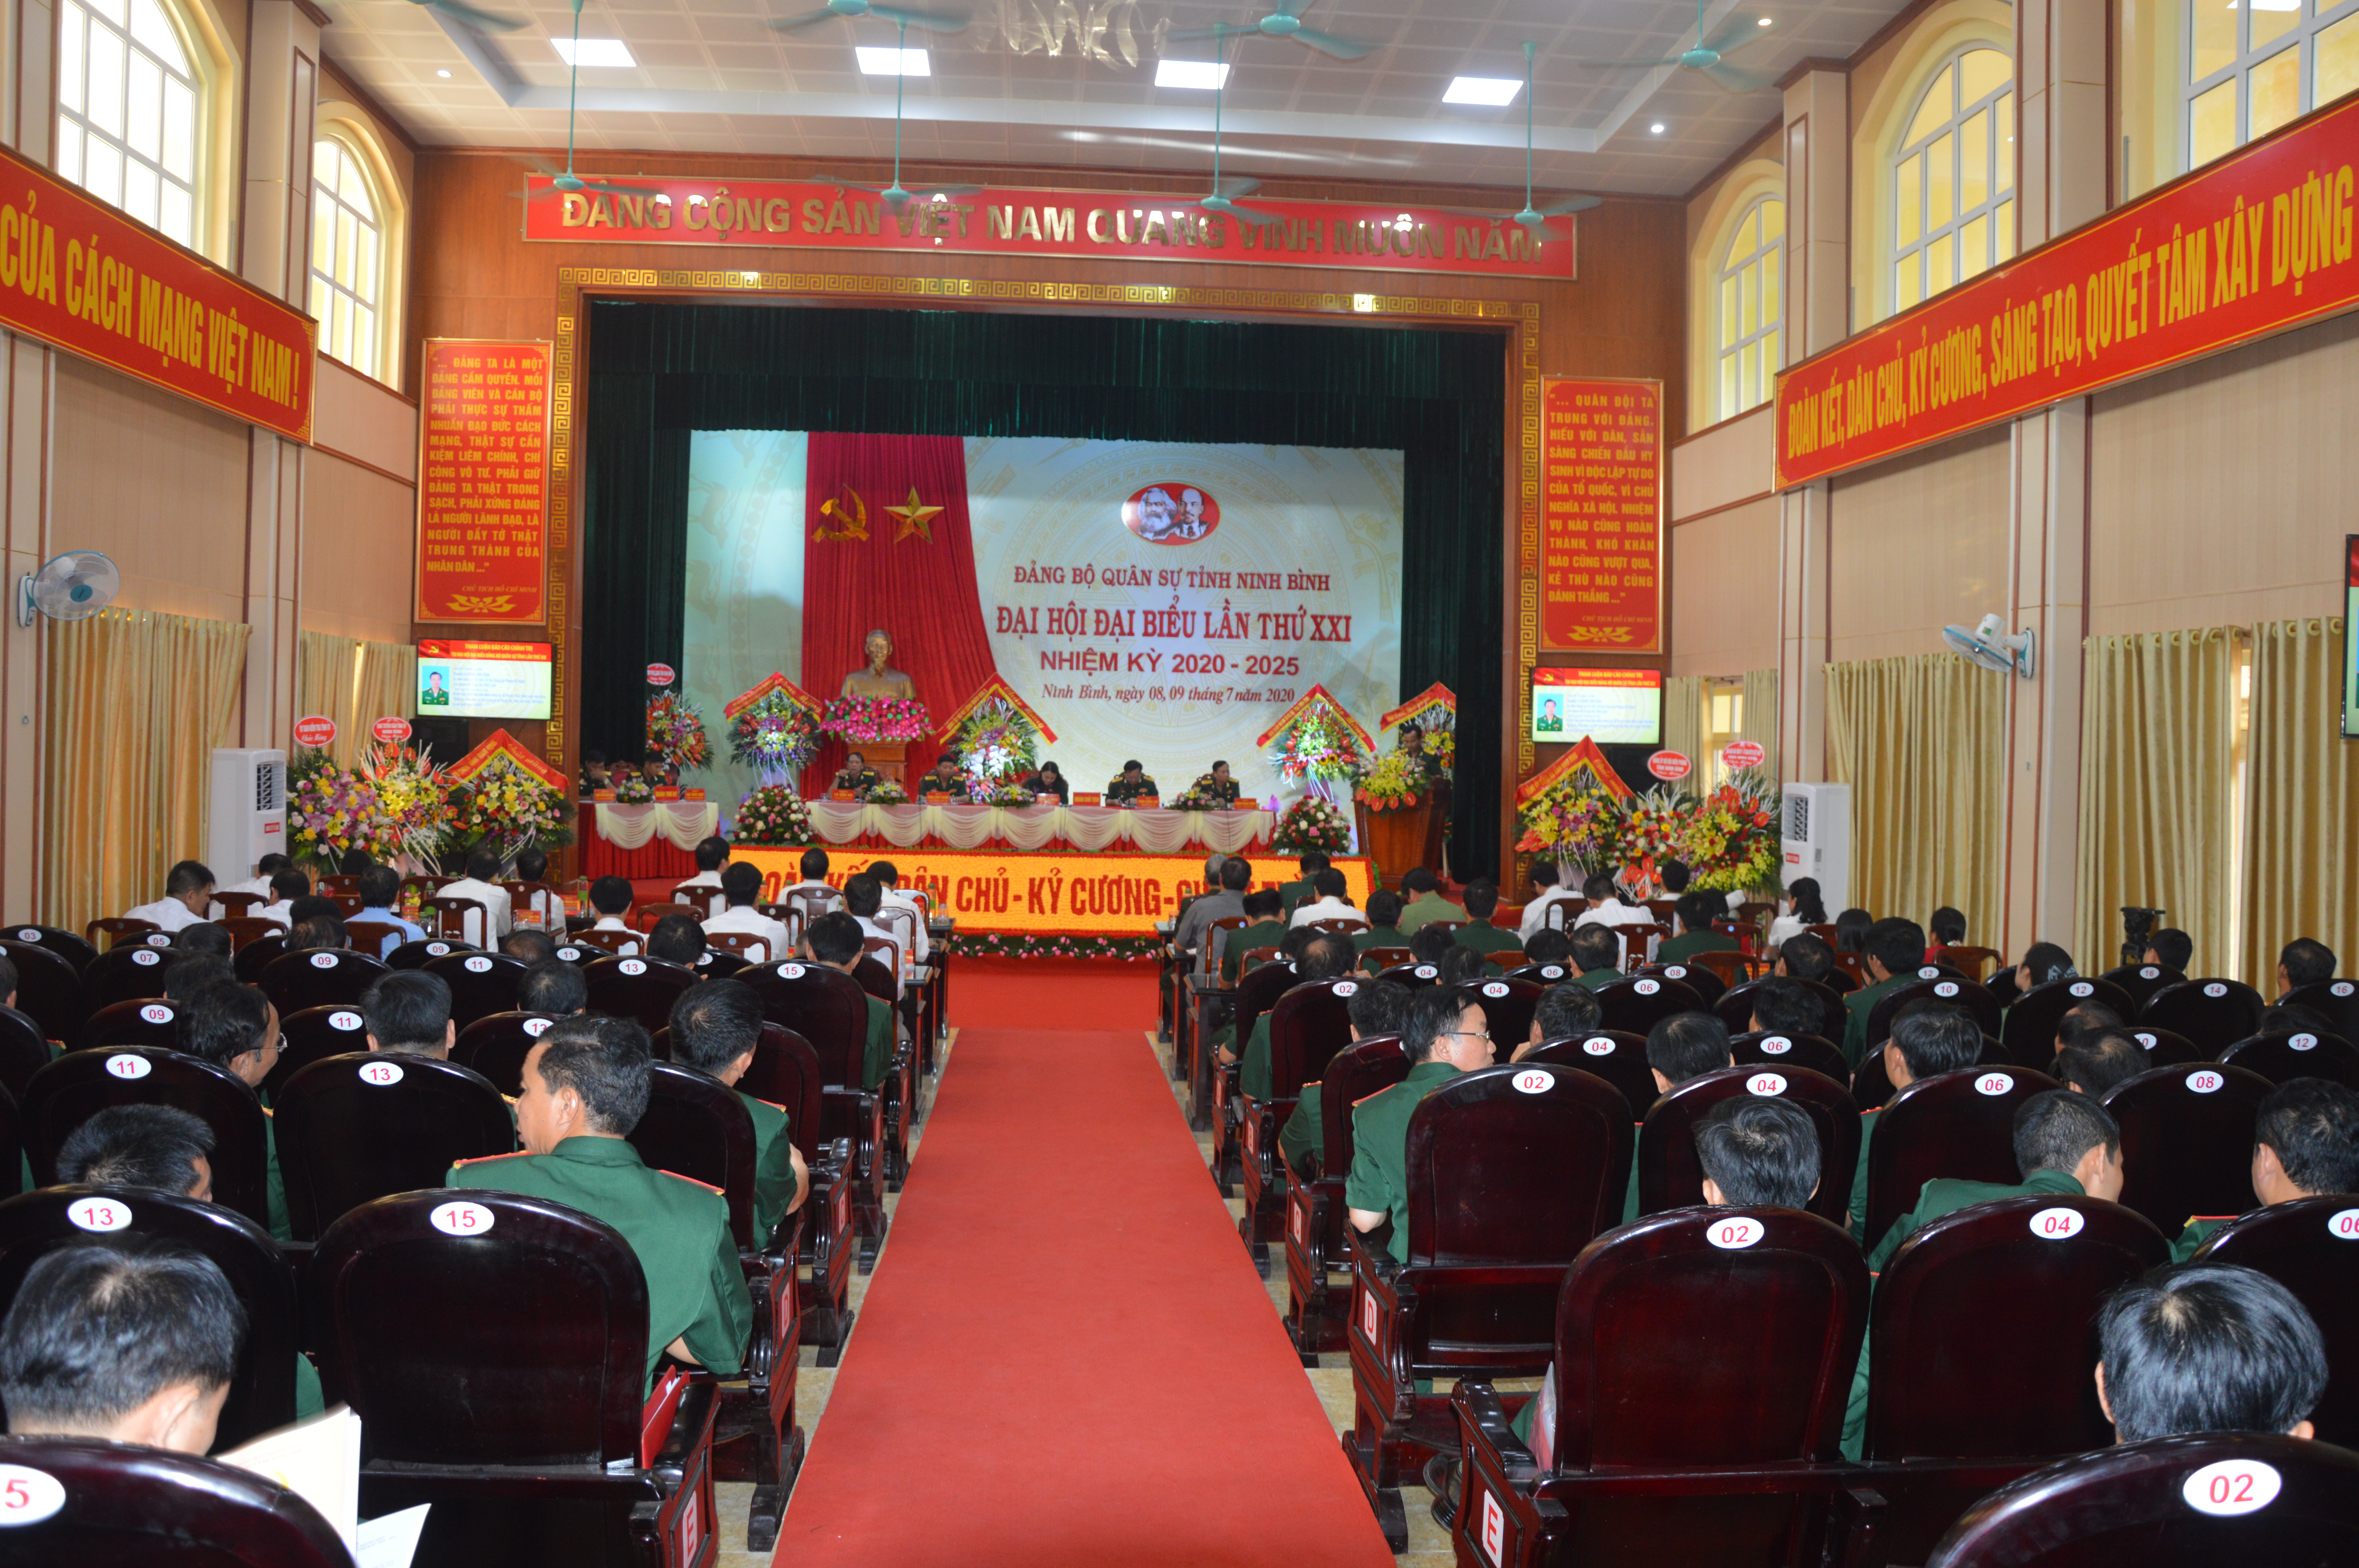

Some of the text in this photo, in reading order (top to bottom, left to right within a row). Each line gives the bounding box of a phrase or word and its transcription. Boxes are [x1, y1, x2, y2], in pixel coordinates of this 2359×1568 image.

[562, 181, 1541, 263] ĐẢNG CỘNG SẢN VIỆT NAM QUANG VINH MUÔN NĂM
[0, 190, 56, 305] CỦA
[65, 234, 133, 338] CÁCH
[139, 273, 204, 368] MẠNG
[209, 307, 248, 394] VIỆT
[1788, 165, 2353, 459] ĐOÀN KẾT, DÂN CHỦ, KỶ CƯƠNG, SÁNG TẠO, QUYẾT TÂM XÂY DỰNG
[432, 386, 542, 403] ĐẢNG VIÊN VÀ CÁN BỘ
[431, 401, 542, 417] PHẢI THỰC SỰ THẤM
[1014, 561, 1330, 591] ĐẢNG BỘ QUÂN SỰ TỈNH NINH BÌNH
[996, 595, 1352, 643] ĐẠI HỘI ĐẠI BIỂU LẦN THỨ XXI
[1041, 647, 1118, 676] NHIỆM
[1128, 648, 1163, 672] KỲ
[1172, 653, 1225, 674] 2020
[1245, 655, 1299, 676] 2025
[1079, 684, 1112, 701] Bình,
[1115, 686, 1145, 703] ngày
[1149, 686, 1166, 702] 08,
[1170, 686, 1185, 700] 09
[1189, 686, 1224, 705] tháng
[1227, 688, 1234, 701] 7
[1235, 689, 1262, 702] năm
[1266, 688, 1295, 702] 2020
[956, 867, 1009, 913] CHỦ
[1028, 867, 1063, 915] KỶ
[24, 932, 36, 940] 03
[432, 945, 444, 954] 09
[140, 953, 153, 962] 07
[318, 957, 332, 965] 09
[472, 961, 483, 969] 11
[625, 964, 638, 973] 13
[784, 966, 798, 976] 15
[1339, 985, 1352, 994] 02
[1489, 986, 1503, 995] 04
[1640, 984, 1654, 992] 06
[149, 1009, 165, 1020] 09
[336, 1016, 351, 1027] 11
[1591, 1042, 1608, 1053] 04
[1767, 1041, 1783, 1051] 06
[2295, 1037, 2309, 1047] 12
[116, 1061, 135, 1074] 11
[370, 1068, 391, 1081] 13
[1523, 1077, 1545, 1090] 02
[1757, 1079, 1777, 1092] 04
[1984, 1078, 2004, 1091] 06
[2196, 1076, 2214, 1088] 08
[83, 1207, 114, 1226] 13
[445, 1210, 477, 1228] 15
[1296, 1210, 1300, 1236] C
[2043, 1215, 2072, 1235] 04
[1721, 1225, 1750, 1244] 02
[1368, 1300, 1374, 1334] D
[2208, 1472, 2255, 1505] 02
[686, 1505, 694, 1559] E
[1487, 1503, 1498, 1556] E
